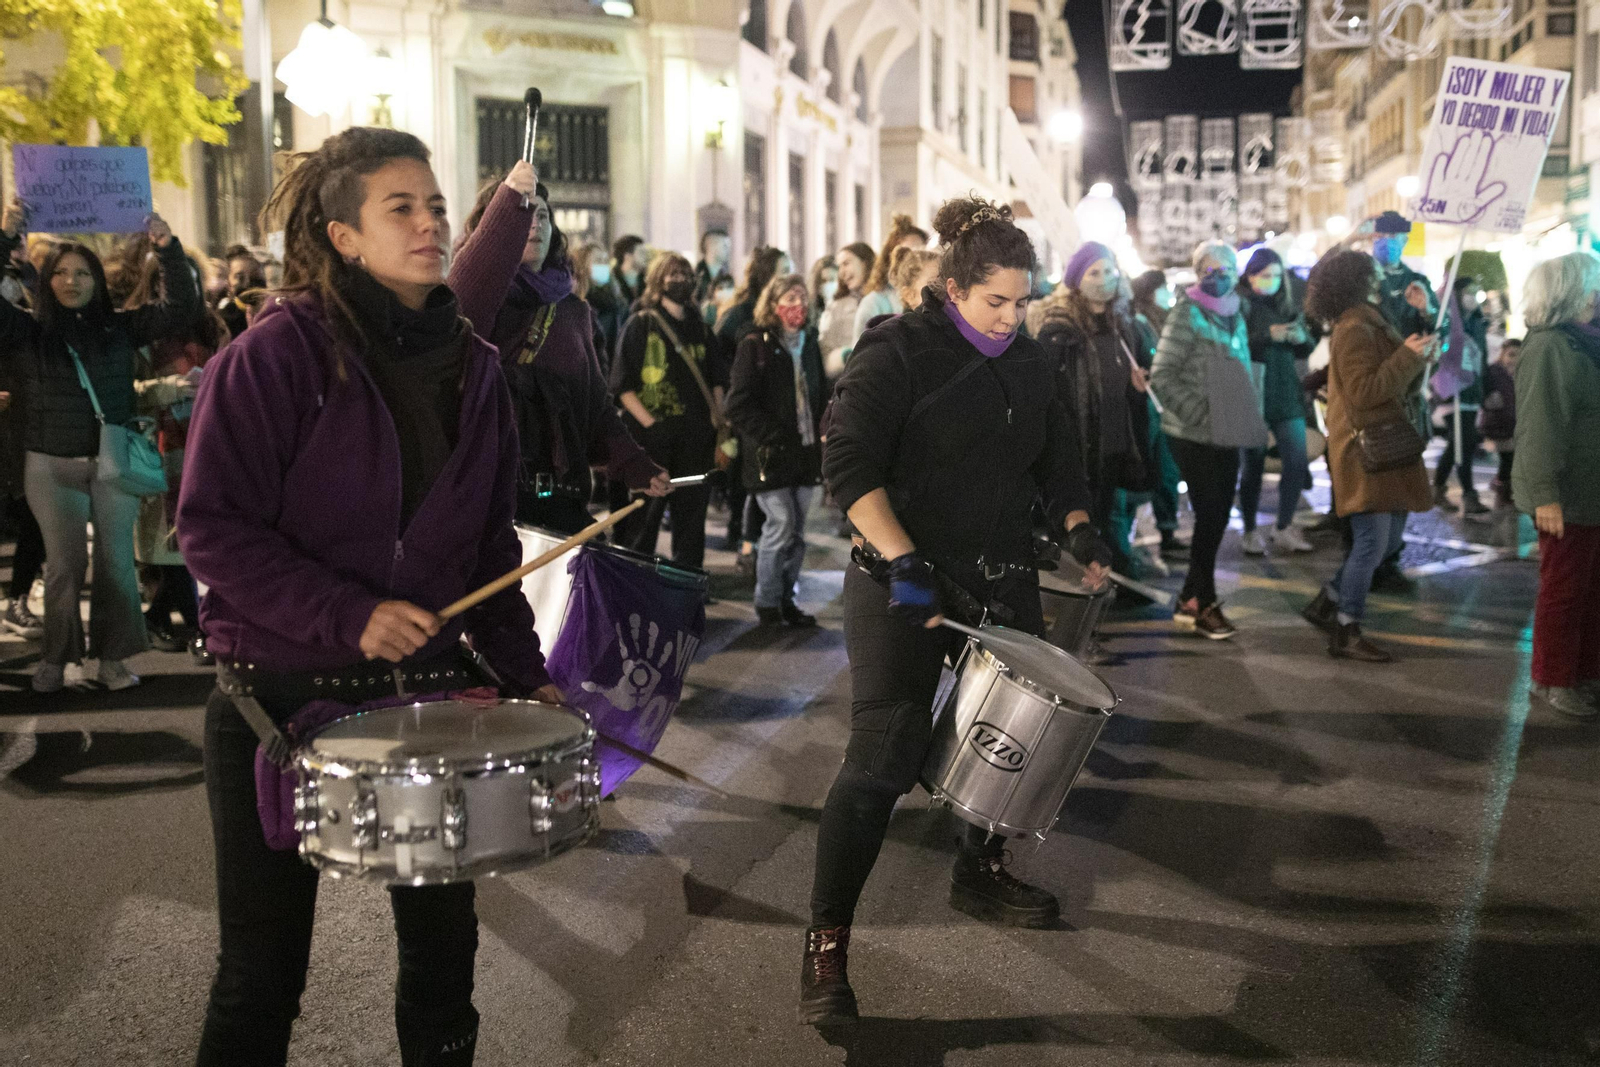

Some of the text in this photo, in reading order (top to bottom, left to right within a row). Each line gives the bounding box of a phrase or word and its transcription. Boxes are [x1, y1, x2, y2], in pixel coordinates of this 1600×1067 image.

[1446, 66, 1565, 107] ¡SOY MUJER Y
[1440, 98, 1555, 137] YO DECIDO MI VIDA!
[1418, 197, 1447, 214] 25N
[972, 727, 1024, 766] IZZO
